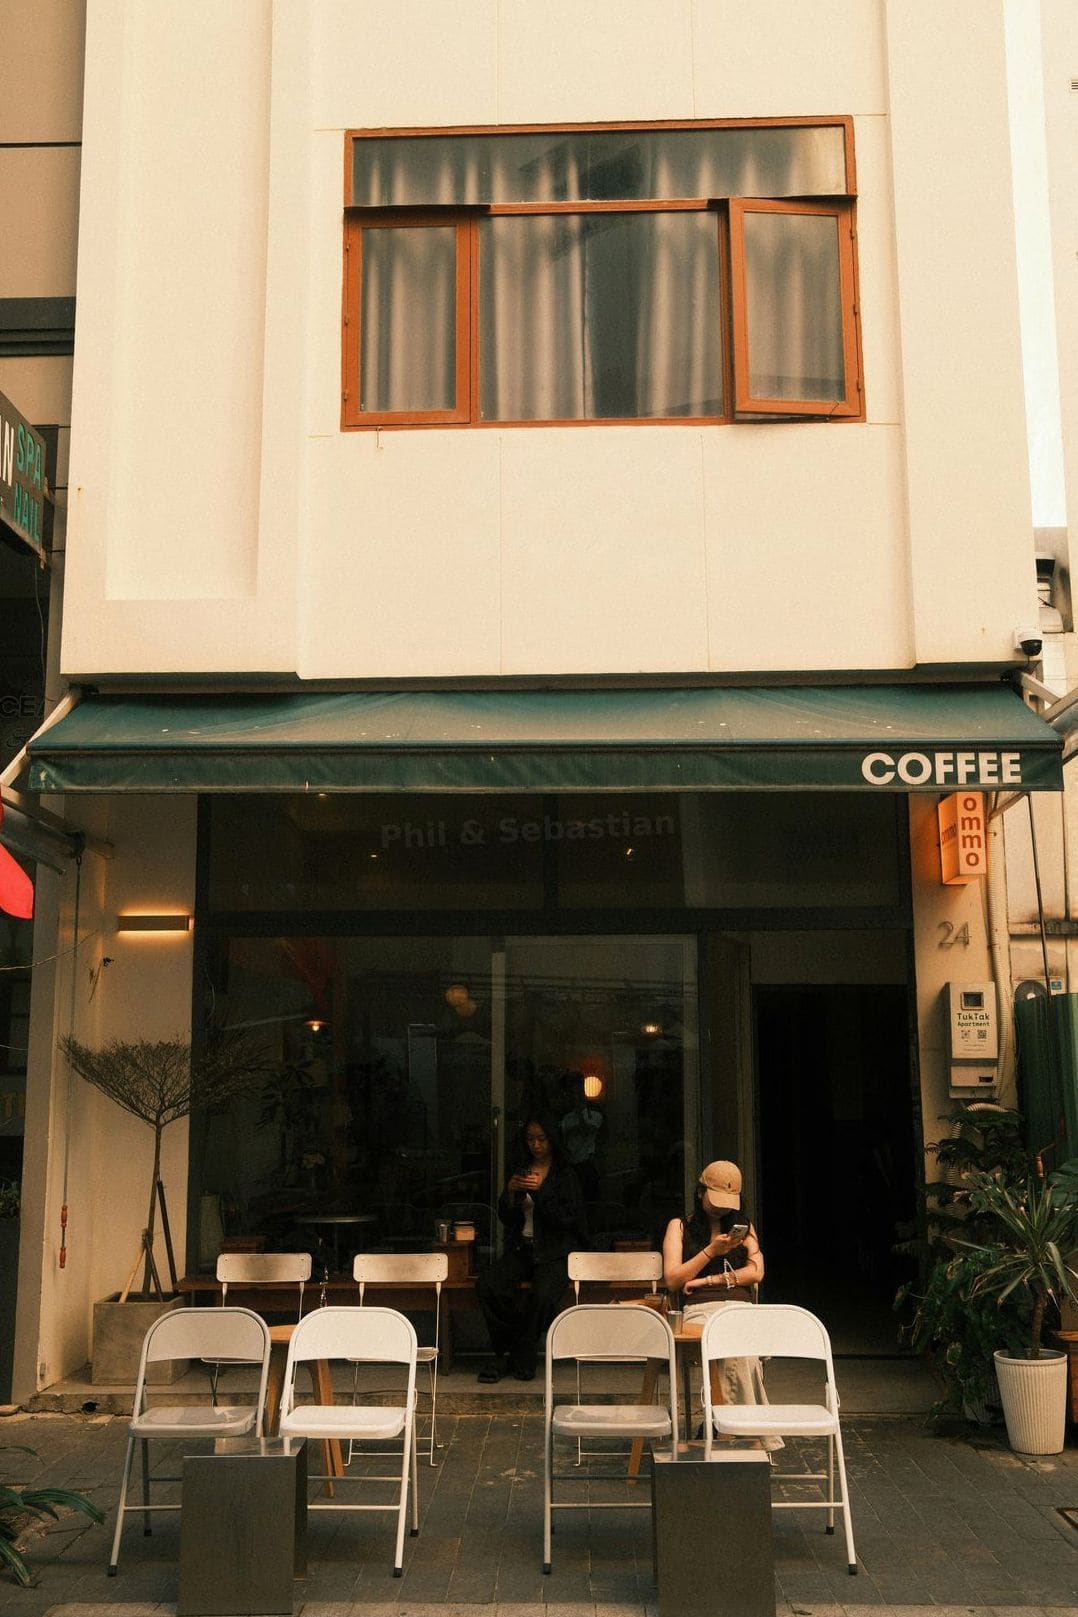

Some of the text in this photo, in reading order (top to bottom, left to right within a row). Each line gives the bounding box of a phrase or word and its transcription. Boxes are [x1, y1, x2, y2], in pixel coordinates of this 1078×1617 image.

[16, 422, 42, 491] SPA
[861, 752, 1022, 785] COFFEE
[381, 811, 675, 849] Phil & Sebastian
[961, 797, 982, 867] ommo
[937, 921, 972, 947] 24
